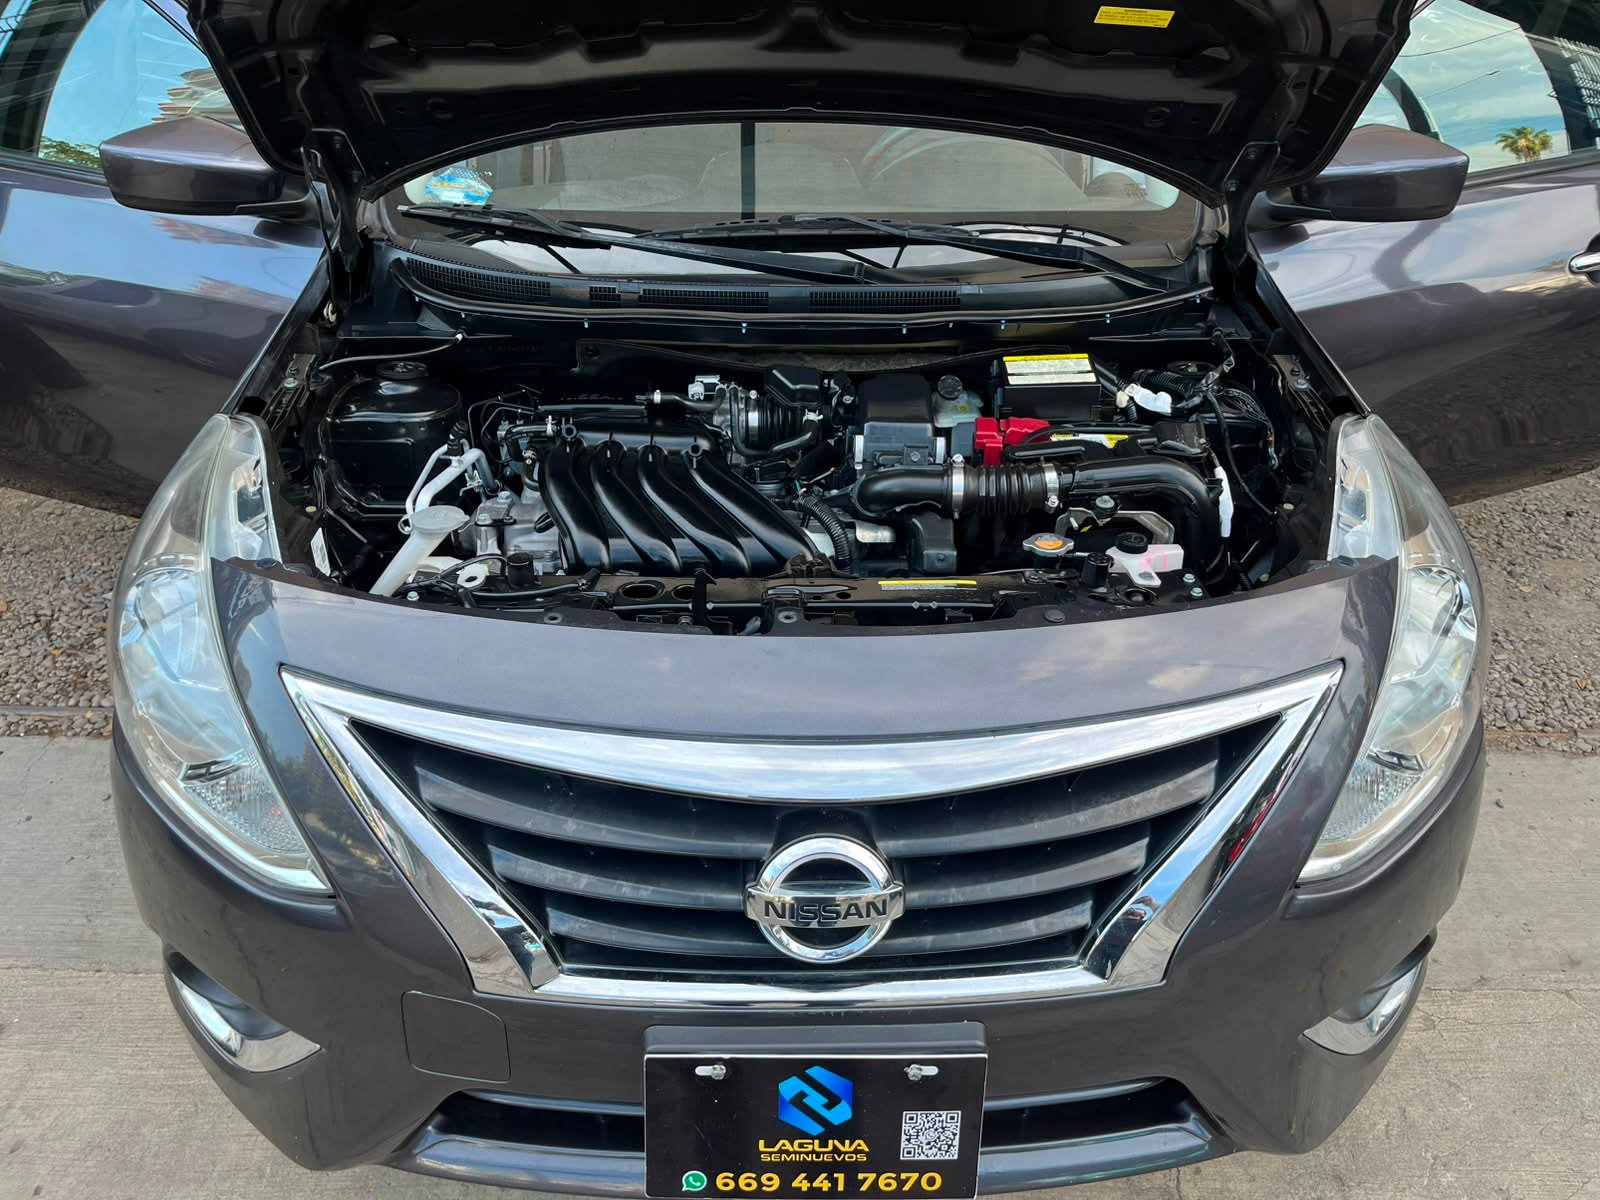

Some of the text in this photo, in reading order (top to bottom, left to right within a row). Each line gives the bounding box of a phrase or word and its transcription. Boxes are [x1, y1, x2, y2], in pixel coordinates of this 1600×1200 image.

[764, 900, 888, 921] NISSAN
[758, 1139, 869, 1152] LAGUNA
[760, 1153, 867, 1162] SEMINUEVOS
[715, 1172, 942, 1192] 669 441 7670
